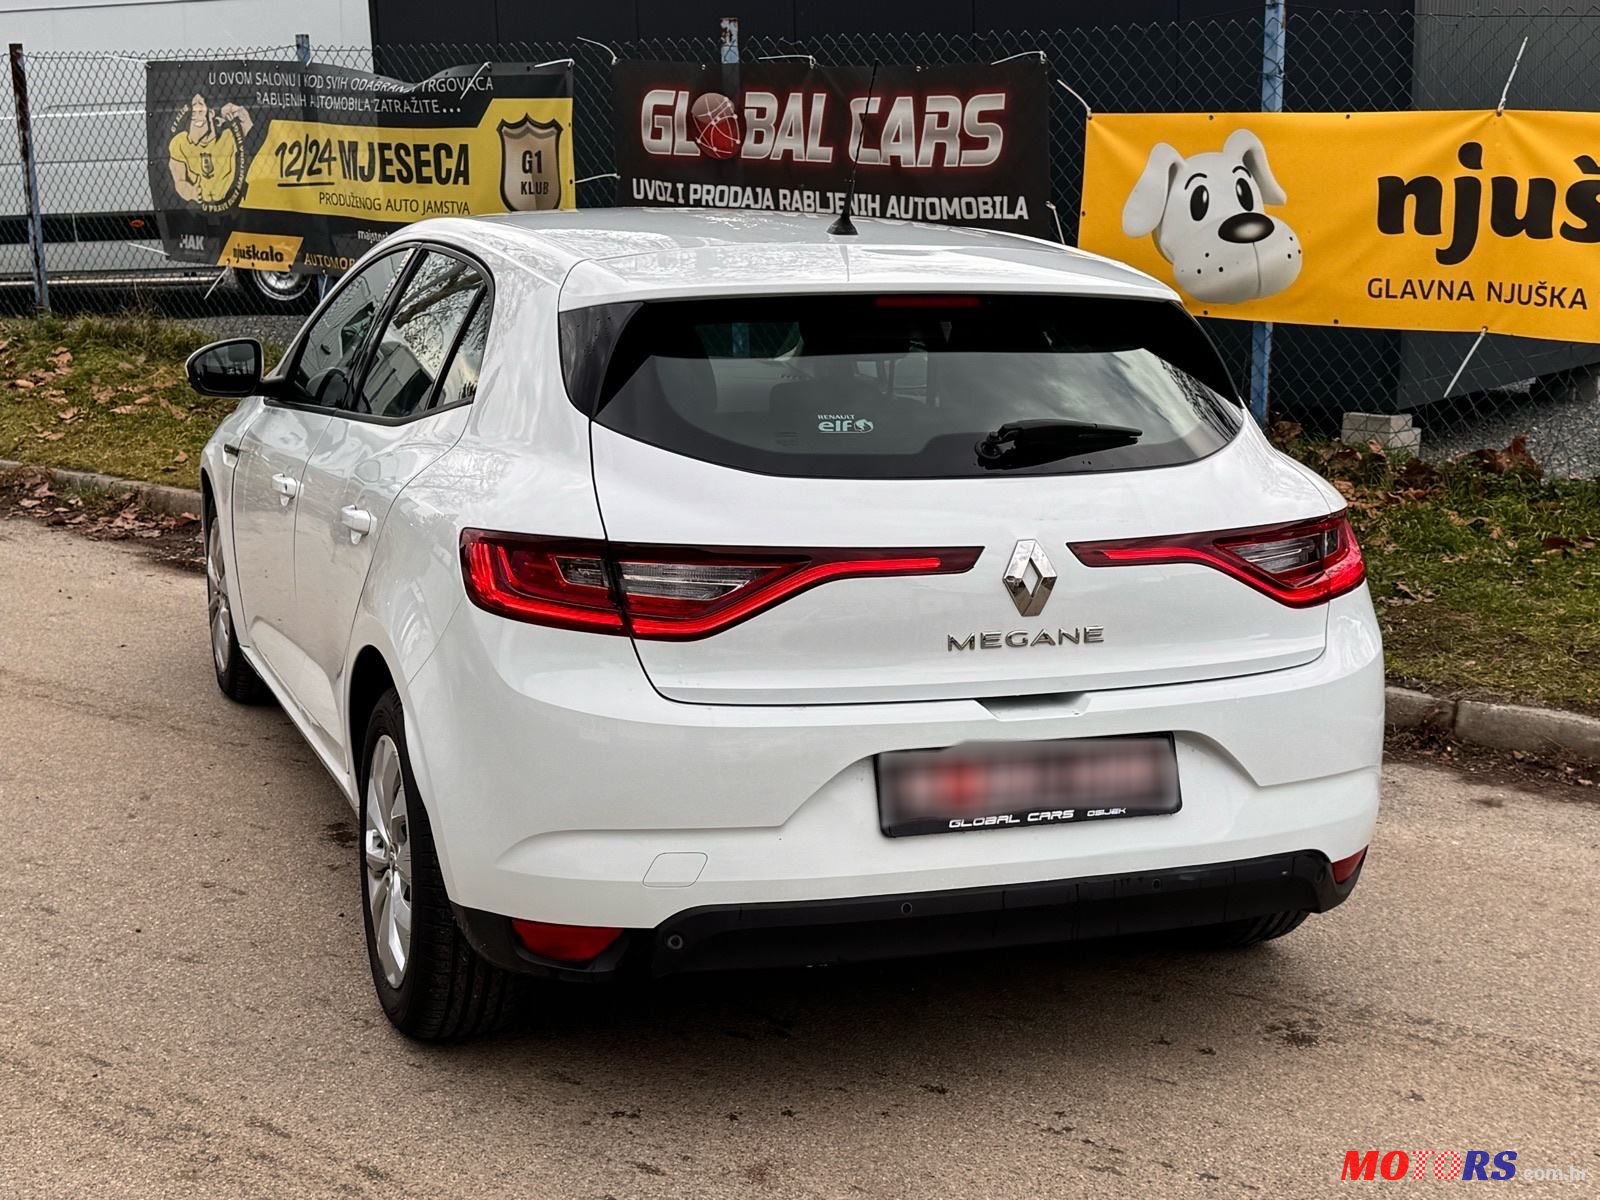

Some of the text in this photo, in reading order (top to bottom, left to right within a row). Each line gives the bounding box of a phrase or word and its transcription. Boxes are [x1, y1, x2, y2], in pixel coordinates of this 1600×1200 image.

[208, 72, 217, 85] U
[218, 72, 252, 86] OVOM
[255, 72, 296, 87] SALONU
[326, 75, 349, 90] SVIH
[420, 76, 494, 93] TRGOVACA
[848, 93, 1006, 168] CARS
[274, 133, 471, 186] 12/24 MJESECA
[521, 149, 544, 174] G1
[519, 180, 550, 196] KLUB
[632, 178, 1029, 221] UVOZ I PRODAJA RABLJENIH AUTOMOBILA
[318, 191, 471, 216] PRODUŽENOG AUTO JAMSTVA
[1367, 277, 1588, 311] GLAVNA NJUŠKA
[948, 625, 1105, 652] MEGANE
[949, 813, 1021, 829] GLOBAL
[1027, 809, 1075, 823] CARS
